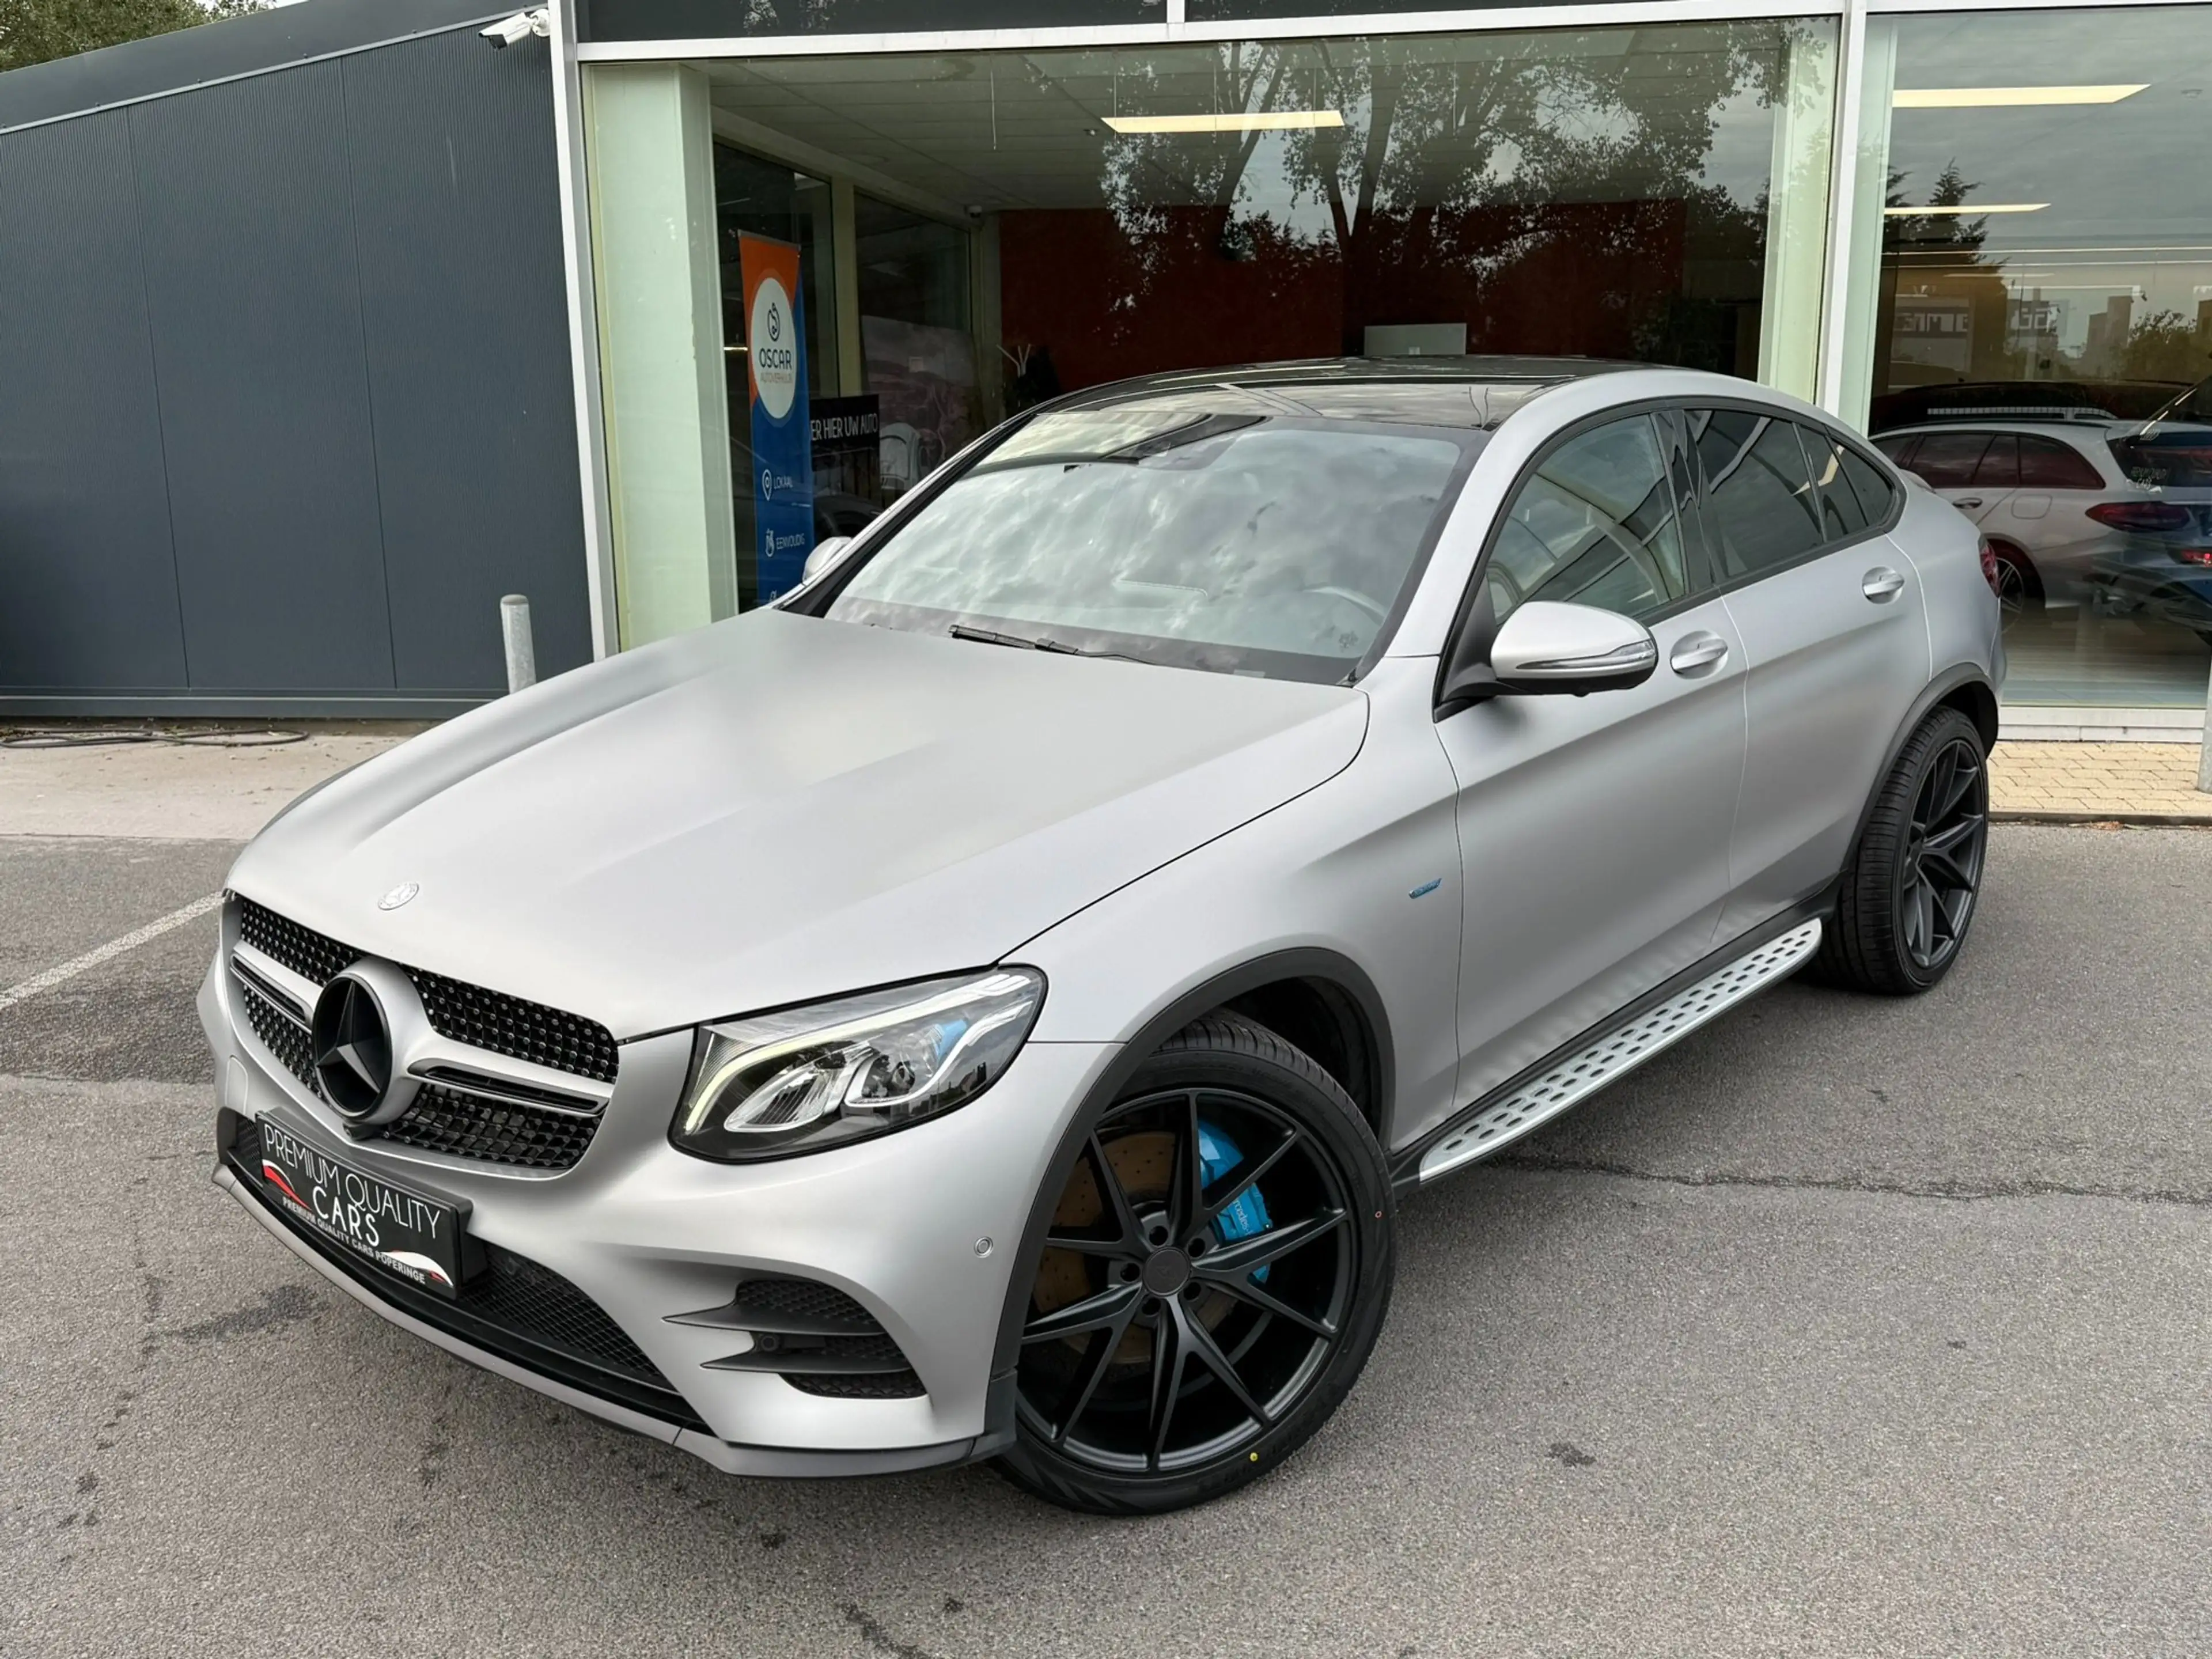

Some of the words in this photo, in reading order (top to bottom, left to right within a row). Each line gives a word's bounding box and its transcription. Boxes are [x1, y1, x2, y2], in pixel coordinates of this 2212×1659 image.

[759, 347, 792, 370] OSCAR
[823, 416, 843, 439] HIER
[844, 415, 859, 437] UW
[860, 412, 878, 435] AUTO
[264, 1123, 341, 1196] PREMIUM
[346, 1173, 440, 1239] QUALITY
[283, 1196, 316, 1225] PREMIUM
[317, 1218, 349, 1244] QUALITY
[352, 1238, 374, 1257] CARS
[375, 1250, 426, 1285] POPERINGE
[313, 1186, 379, 1247] CARS
